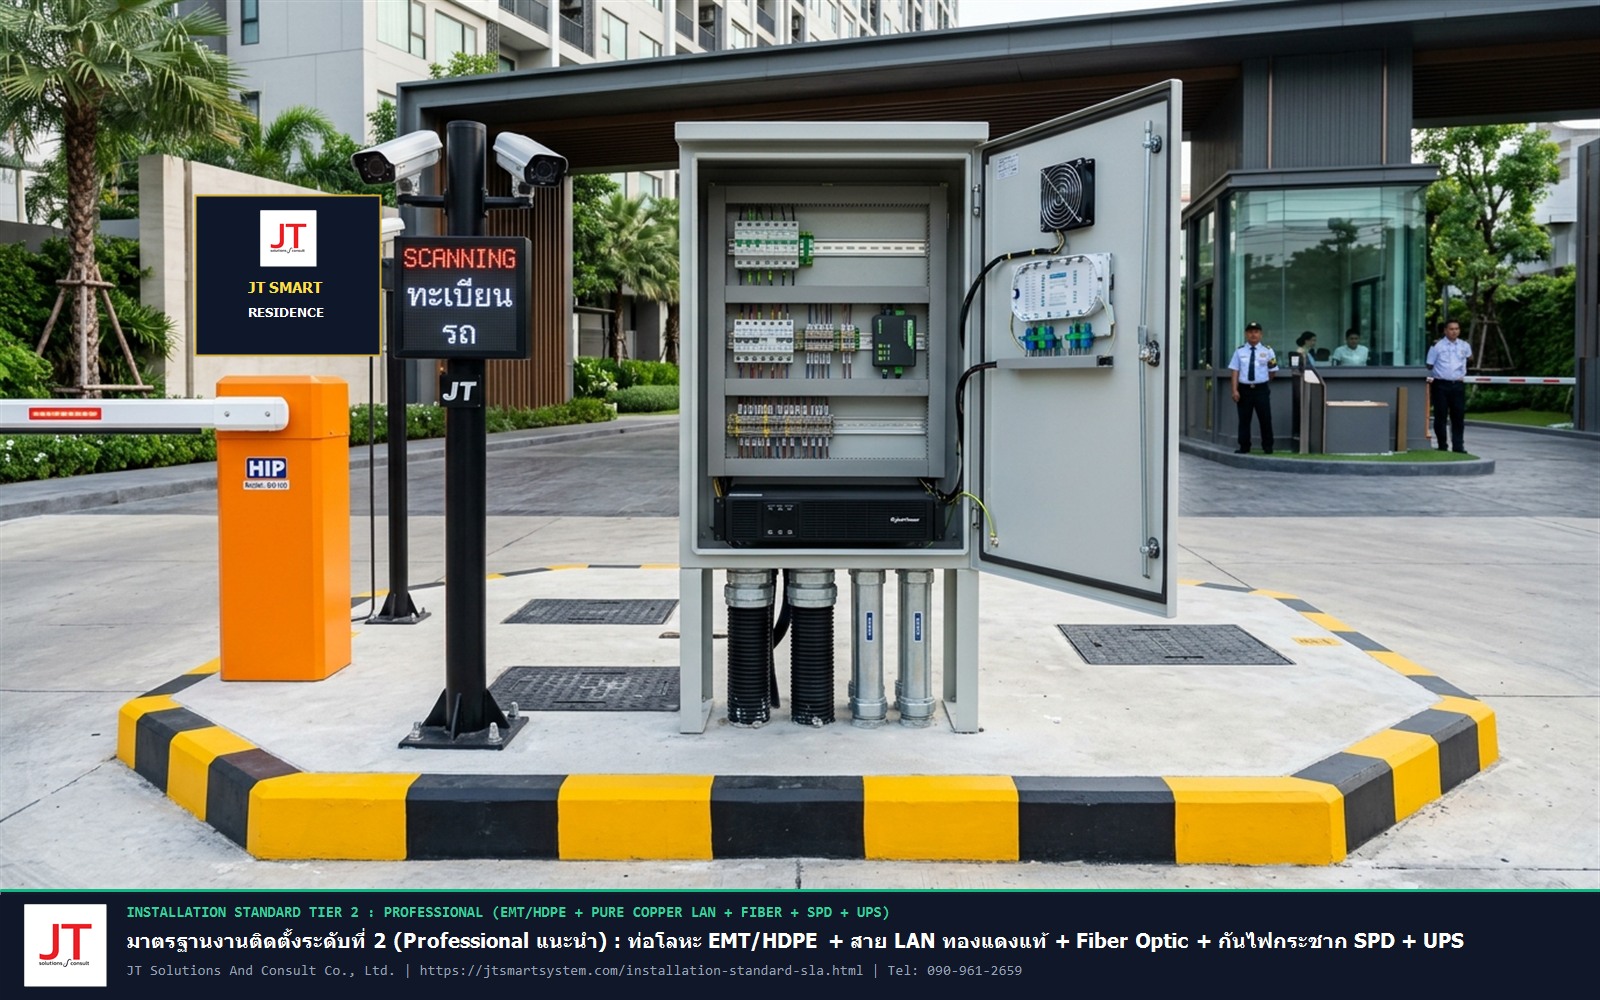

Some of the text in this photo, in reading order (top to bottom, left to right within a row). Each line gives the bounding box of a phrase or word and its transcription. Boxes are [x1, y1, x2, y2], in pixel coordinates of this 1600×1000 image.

[270, 223, 307, 248] JT
[404, 248, 516, 269] SCANNING
[247, 281, 323, 295] JT SMART
[407, 277, 513, 308] ทะเบียน
[248, 307, 325, 318] RESIDENCE
[442, 324, 477, 345] รถ
[442, 381, 477, 402] JT
[249, 460, 285, 477] HIP
